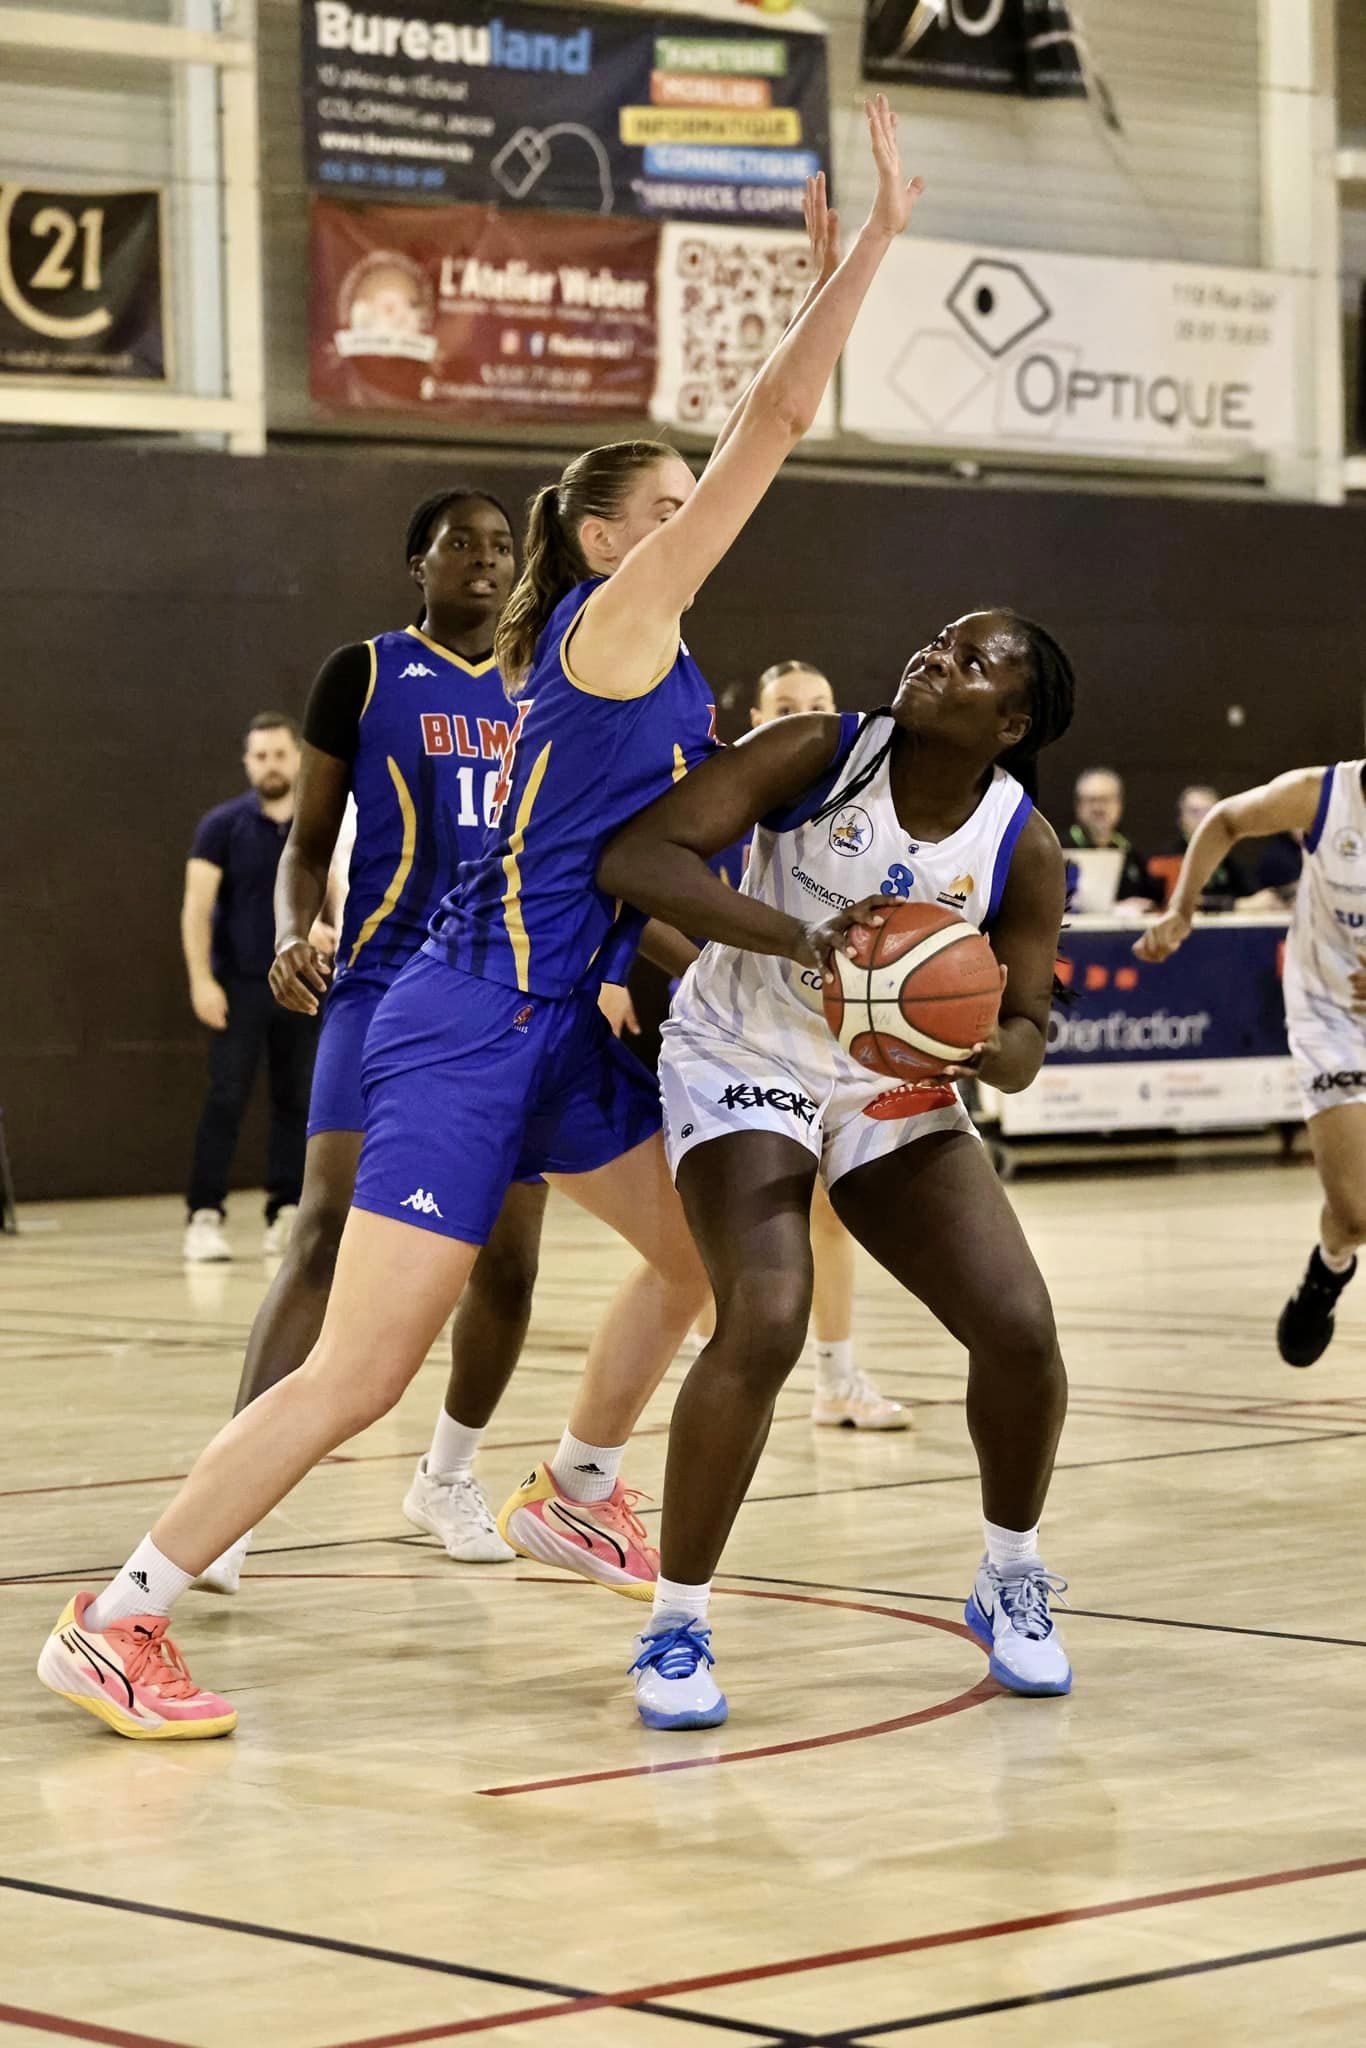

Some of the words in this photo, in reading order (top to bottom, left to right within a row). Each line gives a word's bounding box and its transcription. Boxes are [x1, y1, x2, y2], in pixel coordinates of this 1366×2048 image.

[314, 1, 593, 75] Bureauland
[635, 116, 788, 139] INFORMATIQUE
[30, 206, 104, 291] 21
[1015, 353, 1254, 430] OPTIQUE
[880, 863, 915, 900] 3
